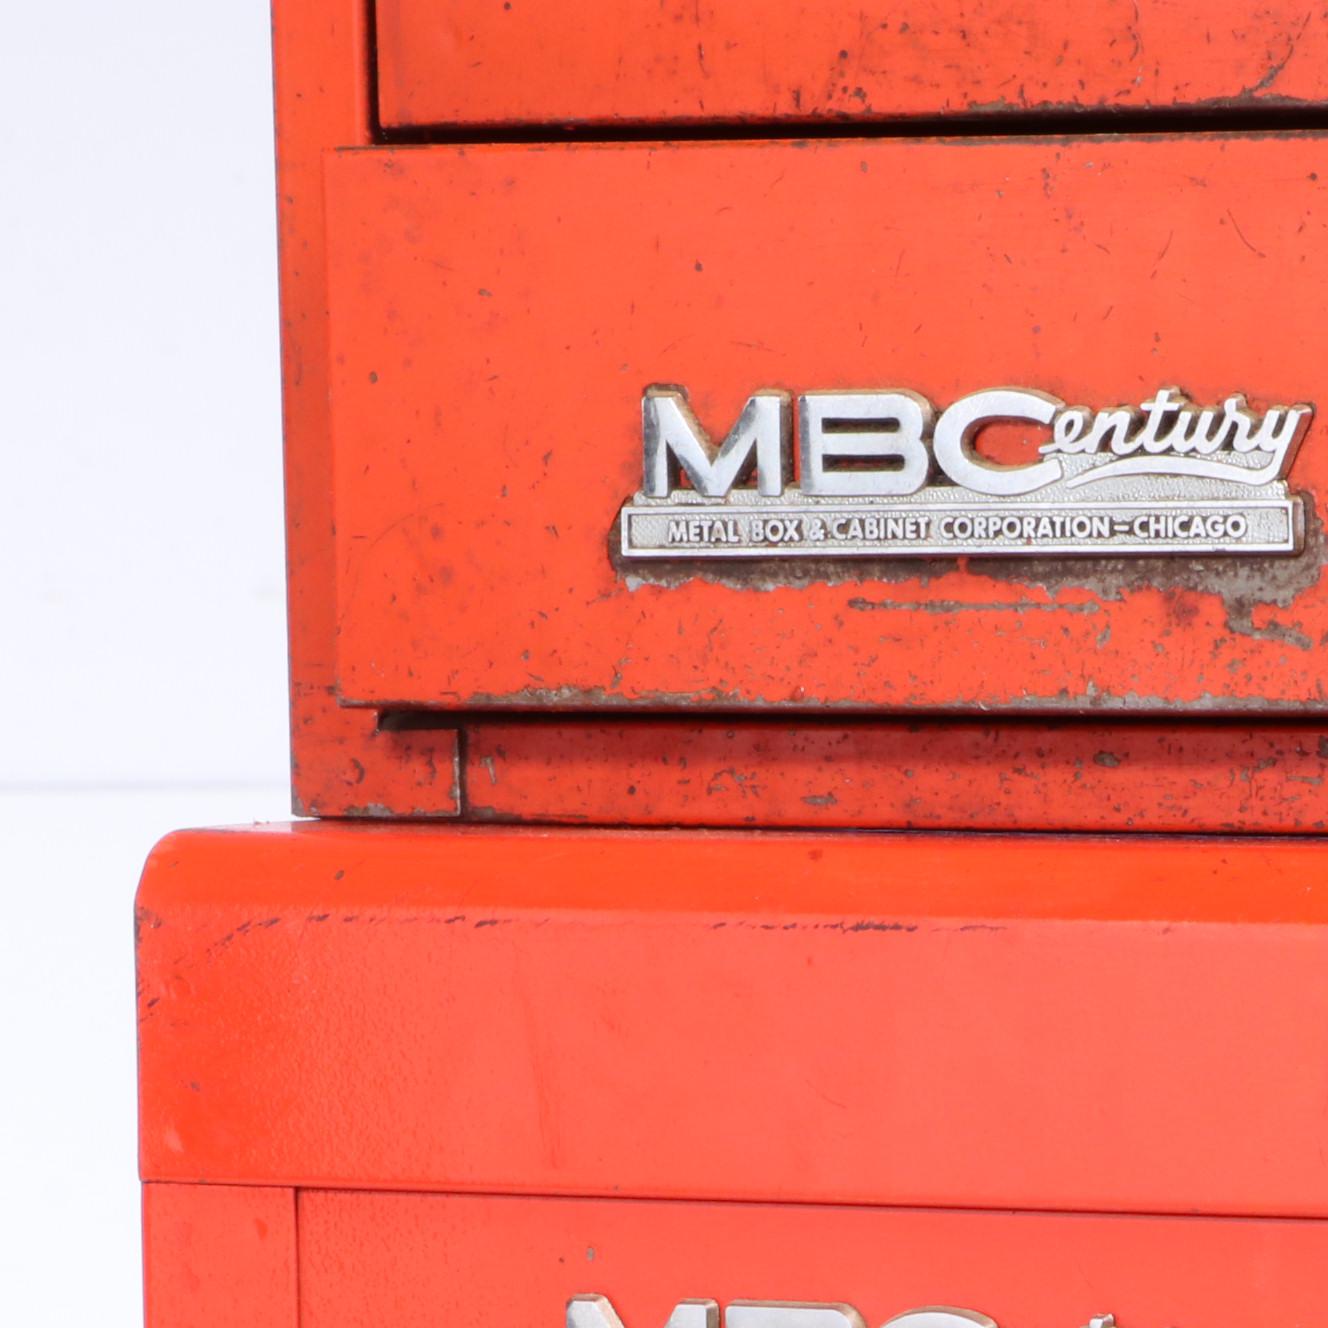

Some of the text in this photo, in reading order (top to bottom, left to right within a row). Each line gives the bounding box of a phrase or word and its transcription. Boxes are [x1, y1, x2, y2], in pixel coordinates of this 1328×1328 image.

[667, 519, 740, 543] METAL
[749, 518, 800, 542] BOX
[809, 518, 826, 541] &
[831, 516, 930, 540] CABINET
